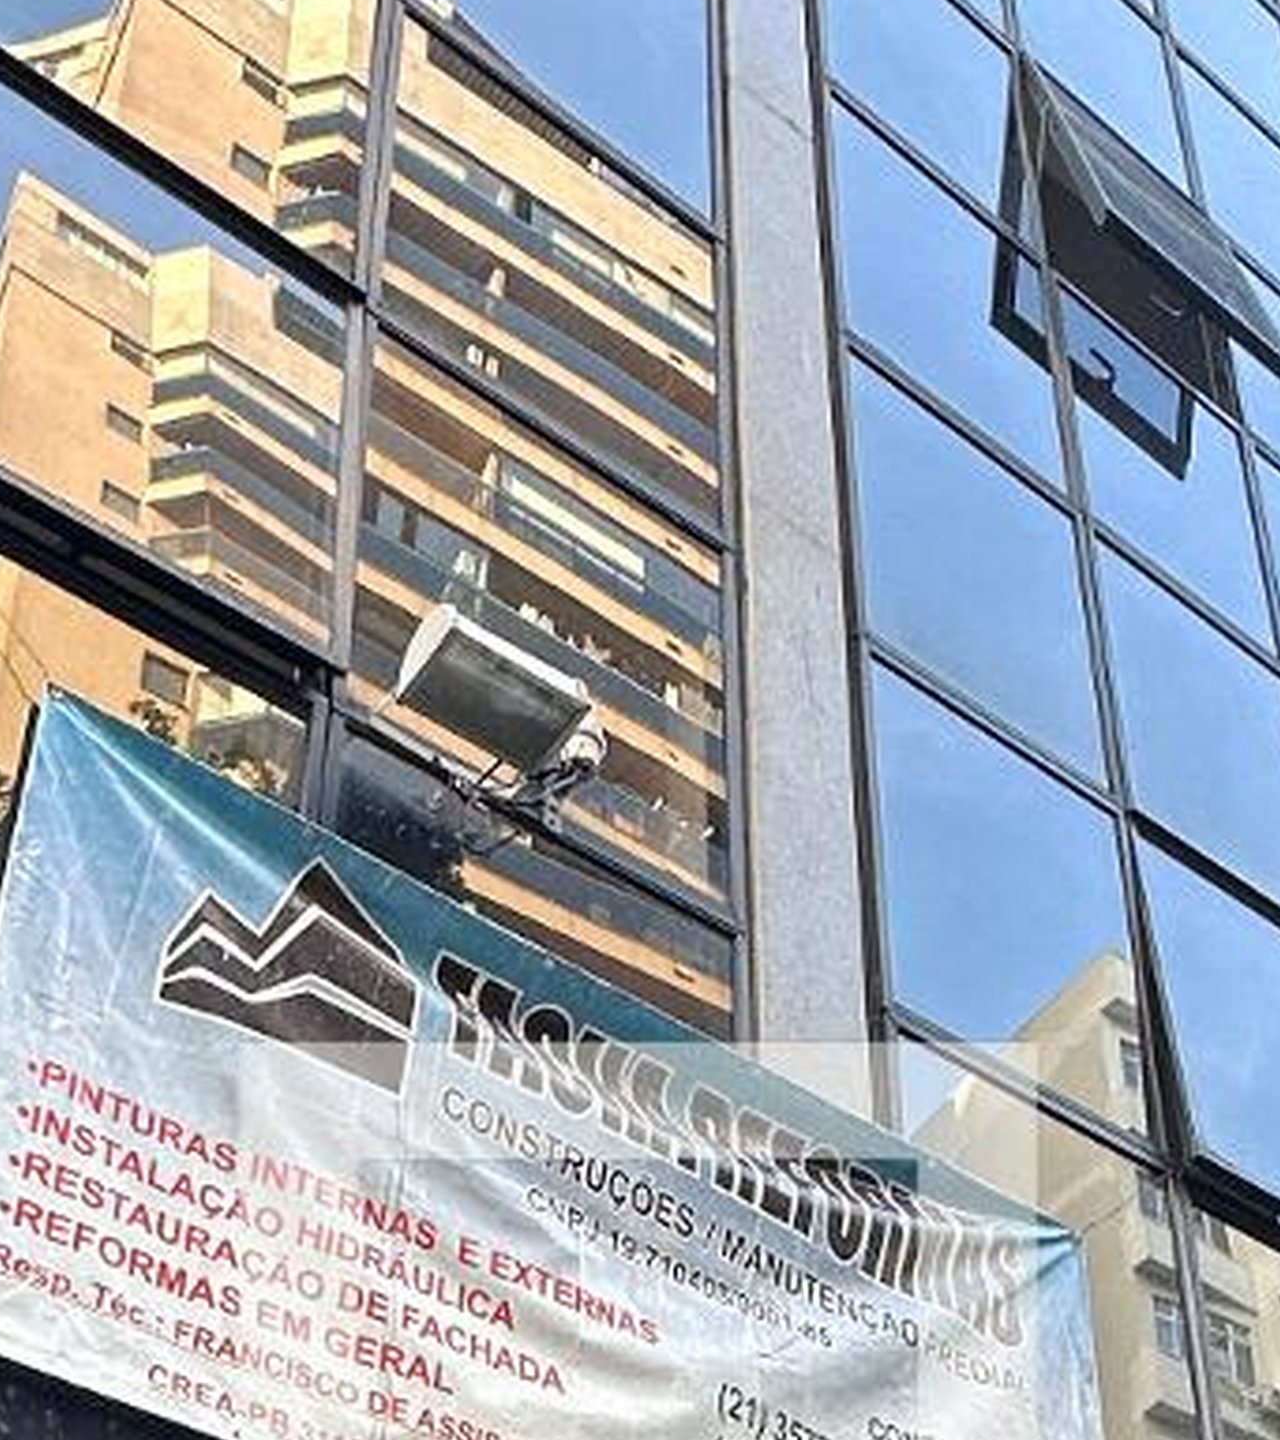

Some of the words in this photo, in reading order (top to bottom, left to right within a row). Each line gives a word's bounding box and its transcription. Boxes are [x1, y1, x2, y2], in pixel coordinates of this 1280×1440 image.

[28, 1104, 285, 1239] INSTALAÇÃO
[297, 1218, 516, 1332] HIDRÁULICA
[39, 1060, 239, 1173] PINTURAS
[250, 1153, 438, 1251] INTERNAS
[457, 1236, 481, 1269] E
[490, 1250, 662, 1346] EXTERNAS
[440, 1086, 696, 1239] CONSTRUÇÕES
[13, 1197, 242, 1318] REFORMAS
[256, 1300, 313, 1343] EM
[323, 1328, 455, 1396] GERAL
[173, 1318, 359, 1406] FRANCISCO
[367, 1389, 410, 1425] DE
[338, 1281, 391, 1326] DE
[401, 1304, 567, 1396] FACHADA
